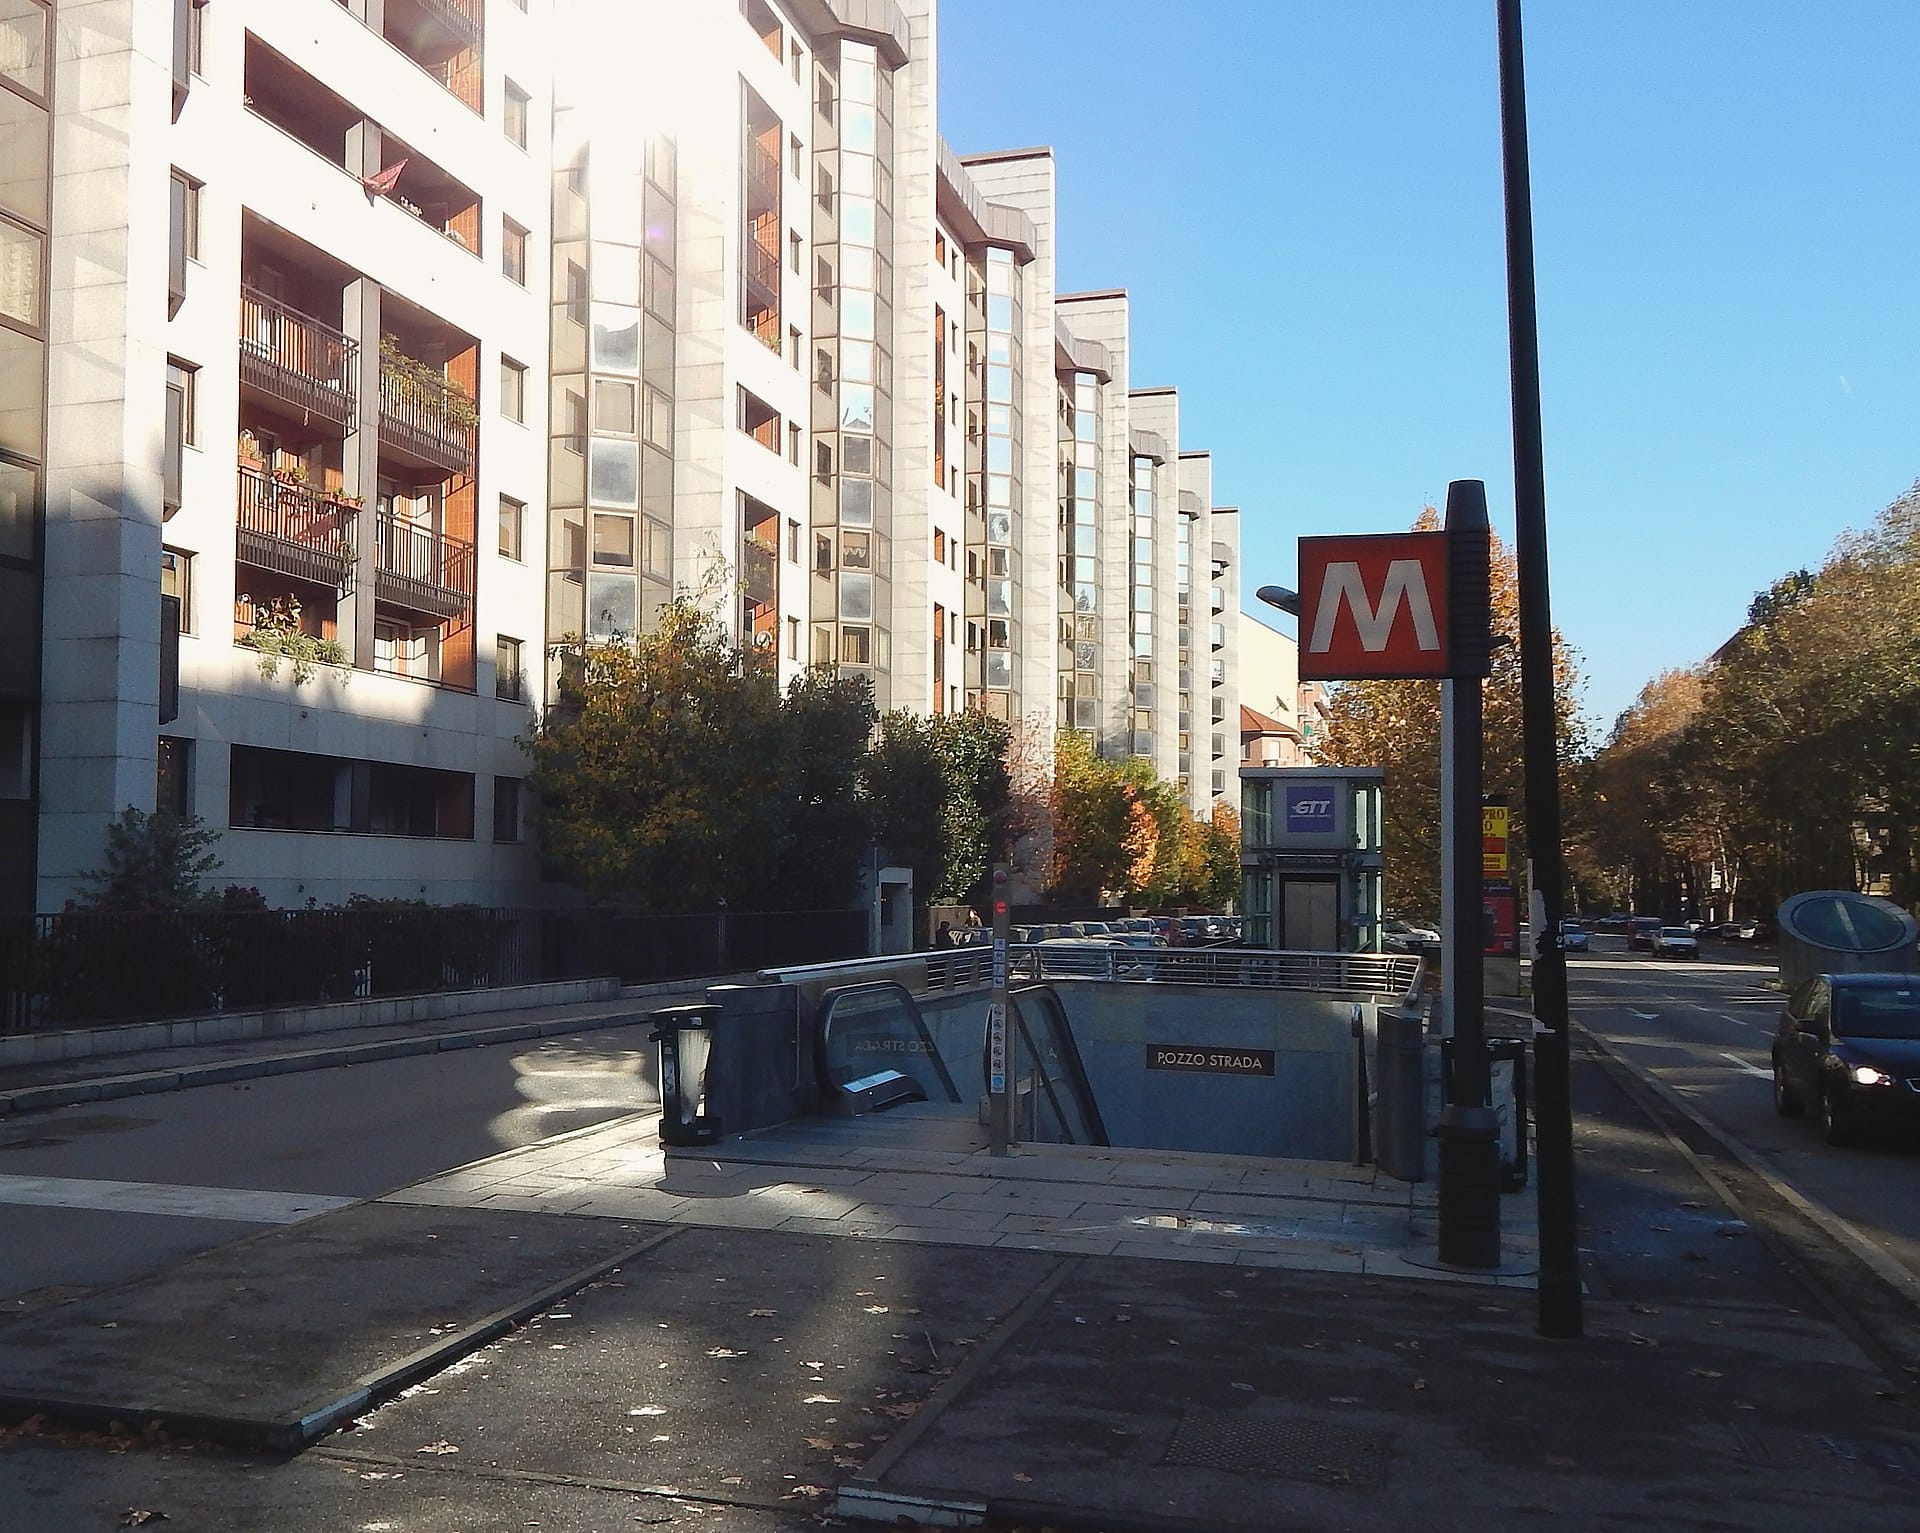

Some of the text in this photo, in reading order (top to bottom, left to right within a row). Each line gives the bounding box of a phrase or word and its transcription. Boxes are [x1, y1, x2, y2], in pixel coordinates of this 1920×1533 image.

[1309, 559, 1440, 653] M
[1294, 800, 1331, 814] GTT
[1209, 1054, 1263, 1069] STRADA
